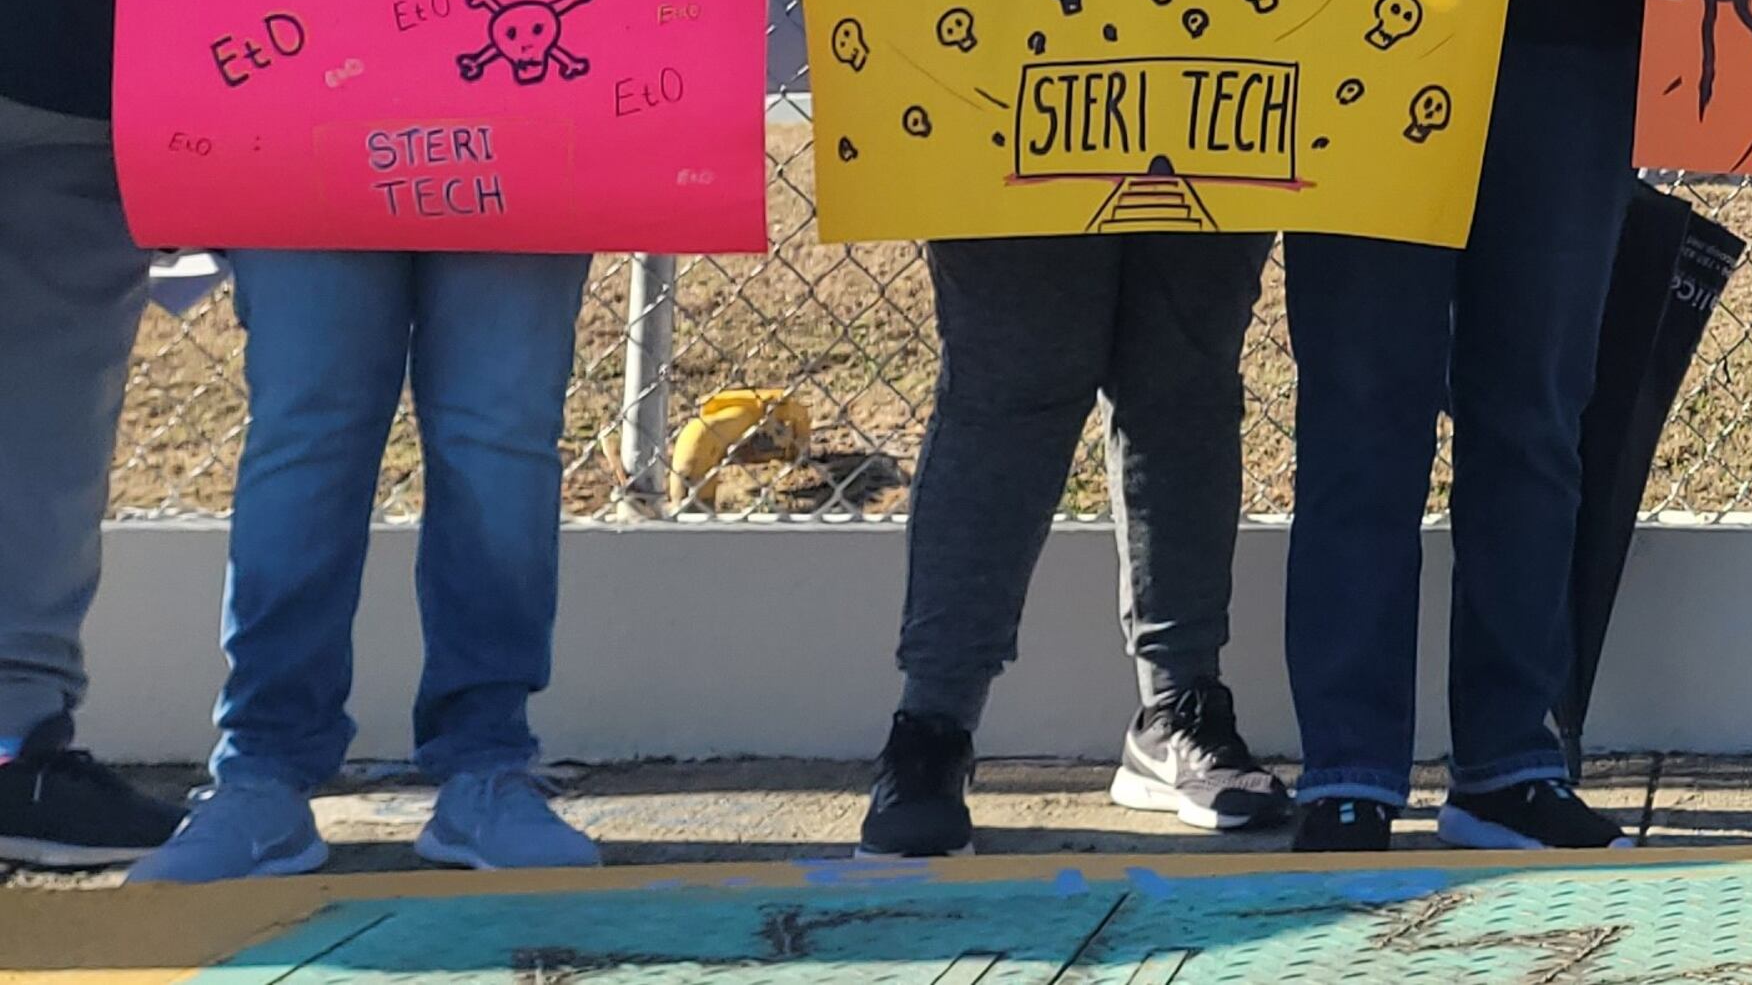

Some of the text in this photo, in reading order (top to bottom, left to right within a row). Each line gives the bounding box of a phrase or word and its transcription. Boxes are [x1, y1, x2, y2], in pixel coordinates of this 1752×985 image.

[211, 13, 305, 88] EtO
[614, 66, 684, 118] EtO
[1028, 69, 1291, 156] STERI TECH
[367, 126, 495, 172] STERI
[373, 174, 507, 217] TECH
